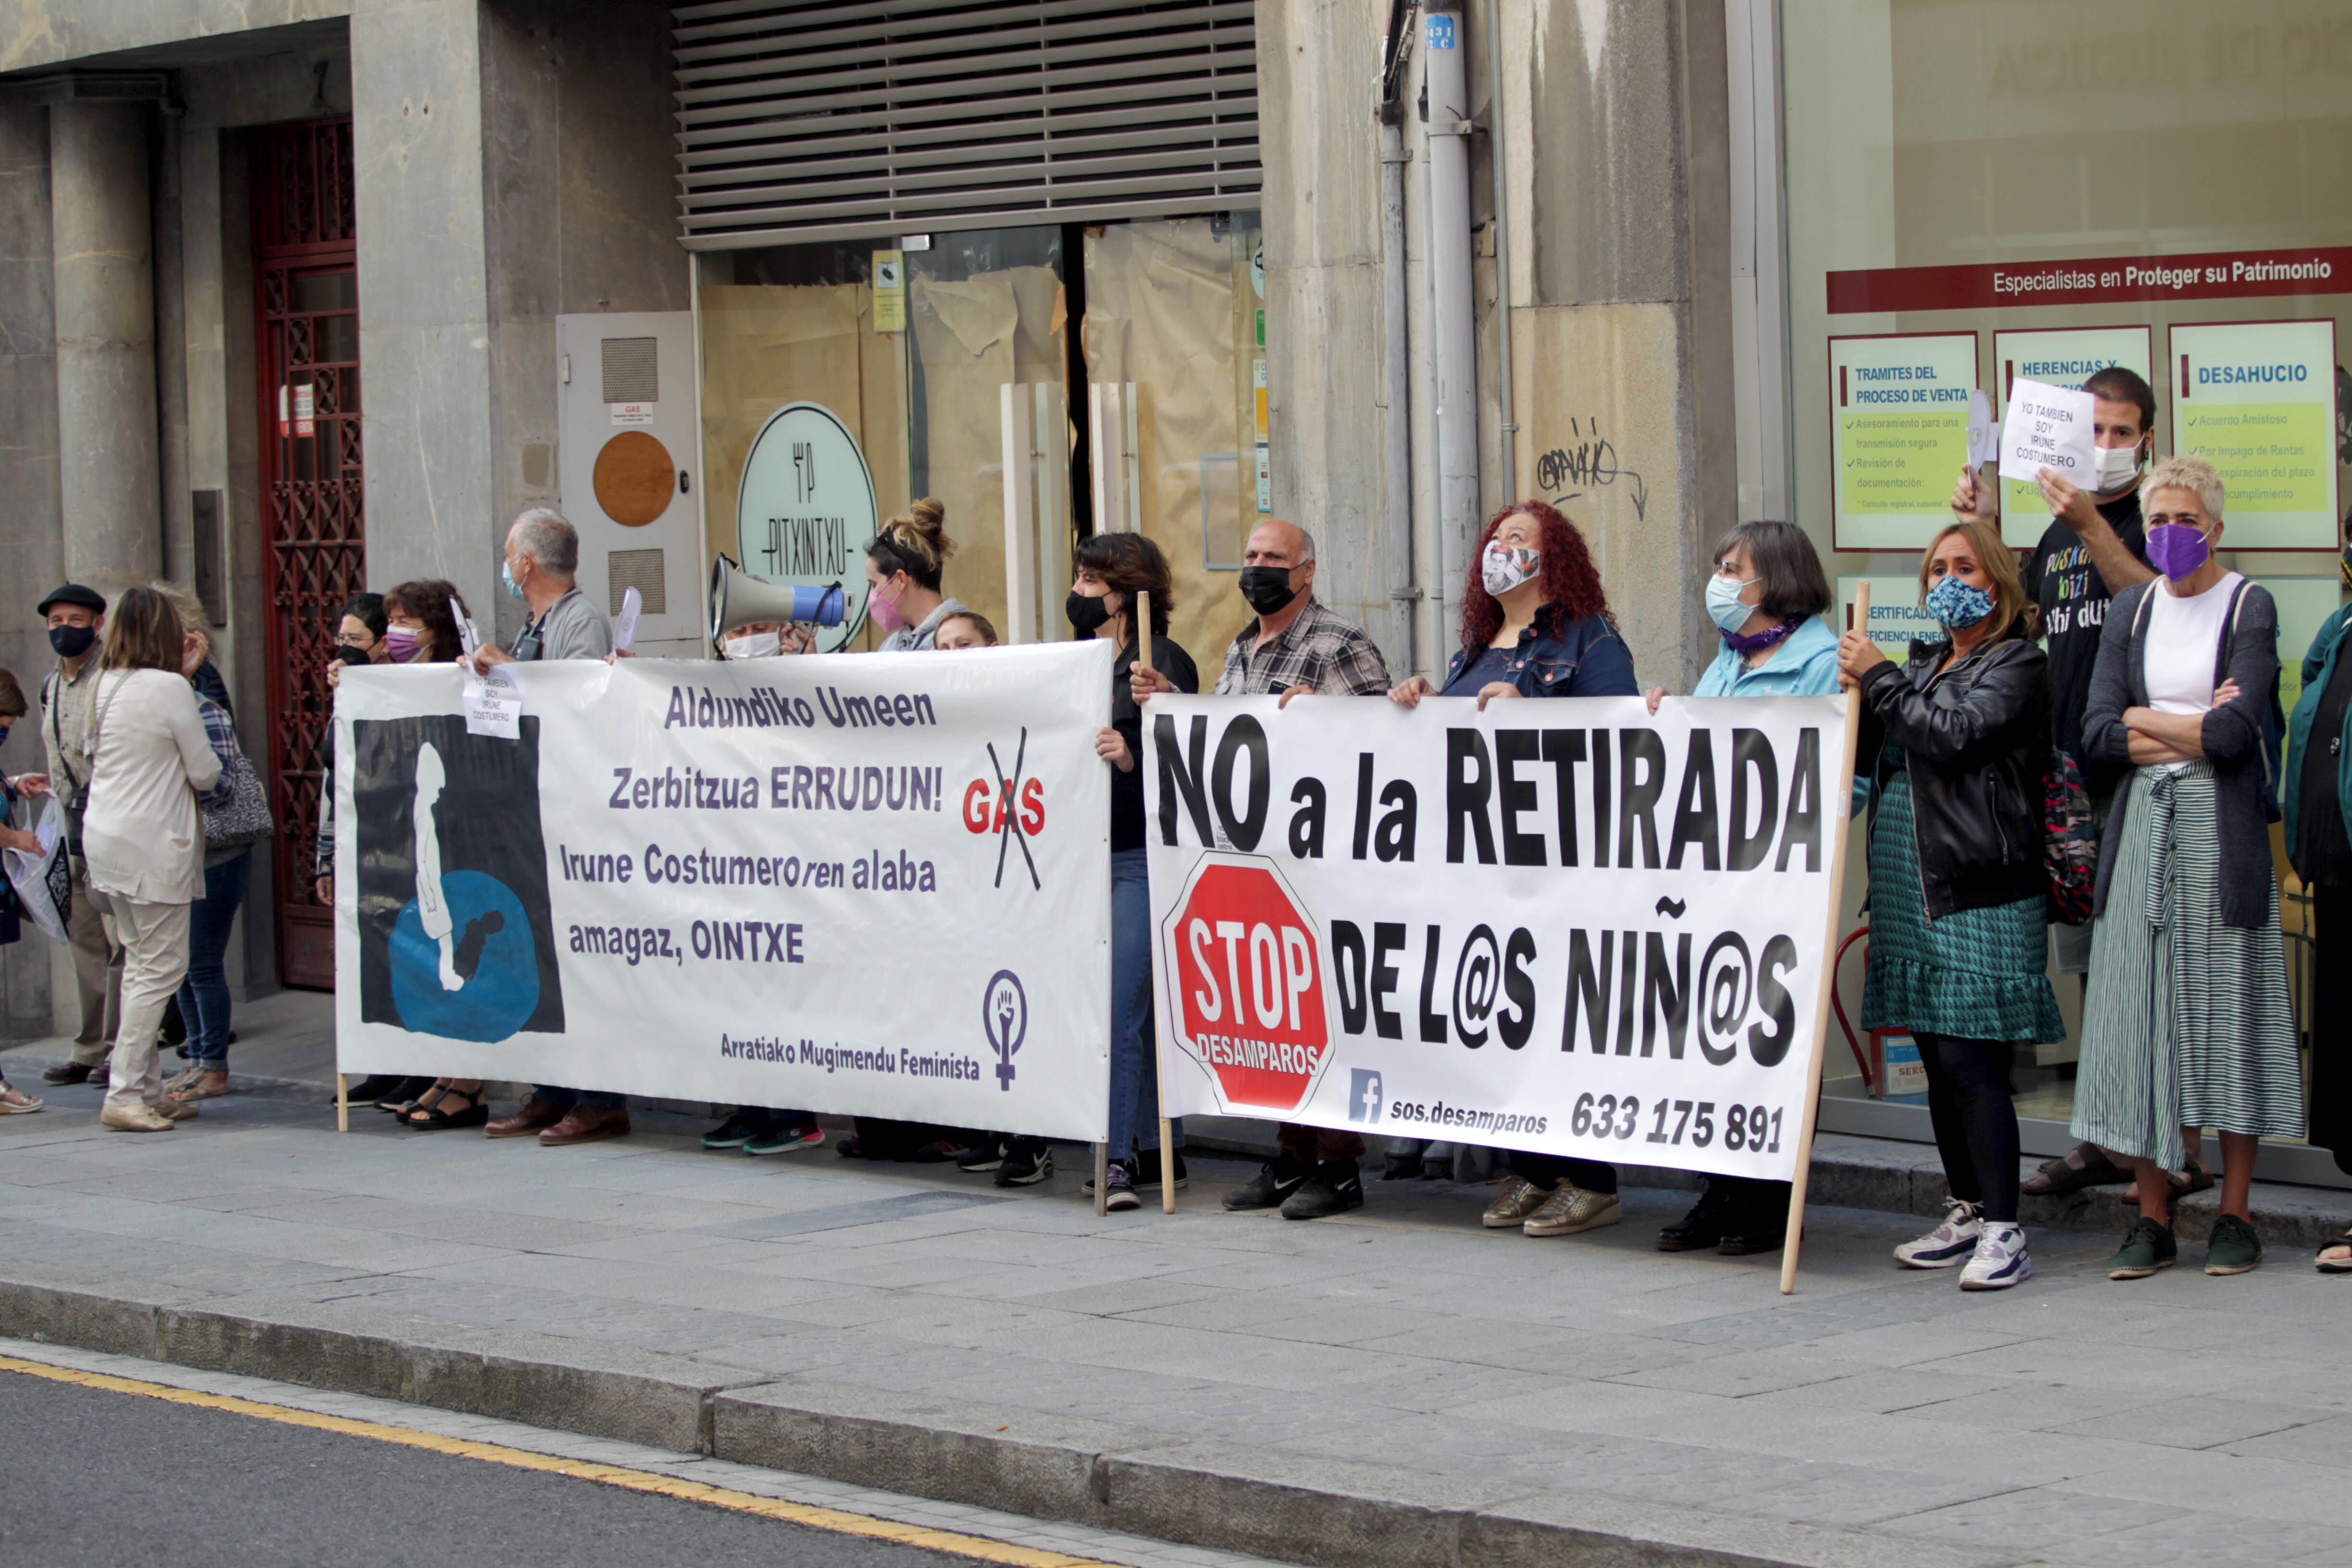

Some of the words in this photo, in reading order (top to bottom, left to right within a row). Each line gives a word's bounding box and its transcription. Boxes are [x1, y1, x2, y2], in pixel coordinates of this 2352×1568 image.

[1993, 269, 2095, 296] Especialistas
[2100, 271, 2120, 288] en
[2125, 264, 2202, 289] Proteger
[2205, 263, 2228, 282] su
[2232, 258, 2331, 282] Patrimonio
[1856, 367, 1913, 381] TRAMITES
[1915, 367, 1937, 380] DEL
[2022, 360, 2103, 376] HERENCIAS
[2198, 364, 2307, 384] DESAHUCIO
[1856, 389, 1909, 403] PROCESO
[1912, 389, 1927, 402] DE
[1929, 389, 1968, 402] VENTA
[2021, 401, 2034, 415] YO
[2036, 405, 2073, 423] TAMBIEN
[2199, 415, 2240, 427] Acuerdo
[2241, 414, 2288, 425] Amistoso
[1856, 418, 1920, 429] Asesoramiento
[1922, 419, 1941, 430] para
[1943, 418, 1959, 428] una
[2035, 421, 2054, 434] SOY
[1856, 438, 1905, 449] transmisión
[1908, 439, 1938, 450] segura
[2031, 435, 2056, 451] IRUNE
[2199, 446, 2216, 456] Por
[2218, 446, 2254, 458] Impago
[2256, 445, 2268, 455] de
[2270, 445, 2304, 455] Rentas
[1856, 458, 1892, 468] Revisión
[1895, 458, 1906, 468] de
[2016, 447, 2075, 468] COSTUMERO
[1857, 477, 1924, 488] documentación:
[2218, 467, 2269, 479] expiración
[2271, 467, 2286, 477] del
[2289, 466, 2315, 479] plazo
[665, 686, 815, 729] Aldundiko
[815, 687, 936, 728] Umeen
[610, 767, 759, 809] Zerbitzua
[772, 765, 942, 812] ERRUDUN!
[1154, 714, 1270, 853] NO
[1289, 777, 1326, 859] a
[1353, 753, 1417, 862] la
[1446, 728, 1821, 872] RETIRADA
[962, 777, 1045, 836] GAS
[560, 845, 633, 882] Irune
[853, 849, 935, 892] alaba
[570, 925, 682, 967] amagaz,
[692, 920, 803, 963] OINTXE
[1189, 918, 1313, 1031] STOP
[1331, 920, 1406, 1039] DE
[1420, 924, 1536, 1050] L@S
[1561, 896, 1797, 1067] NIÑ@S
[722, 1034, 795, 1064] Arratiako
[800, 1040, 895, 1073] Mugimendu
[901, 1048, 979, 1080] Feminista
[1196, 1032, 1320, 1077] DESAMPAROS
[1391, 1101, 1547, 1135] sos.desamparos
[1572, 1092, 1640, 1139] 633
[1647, 1099, 1715, 1147] 175
[1725, 1104, 1782, 1153] 891
